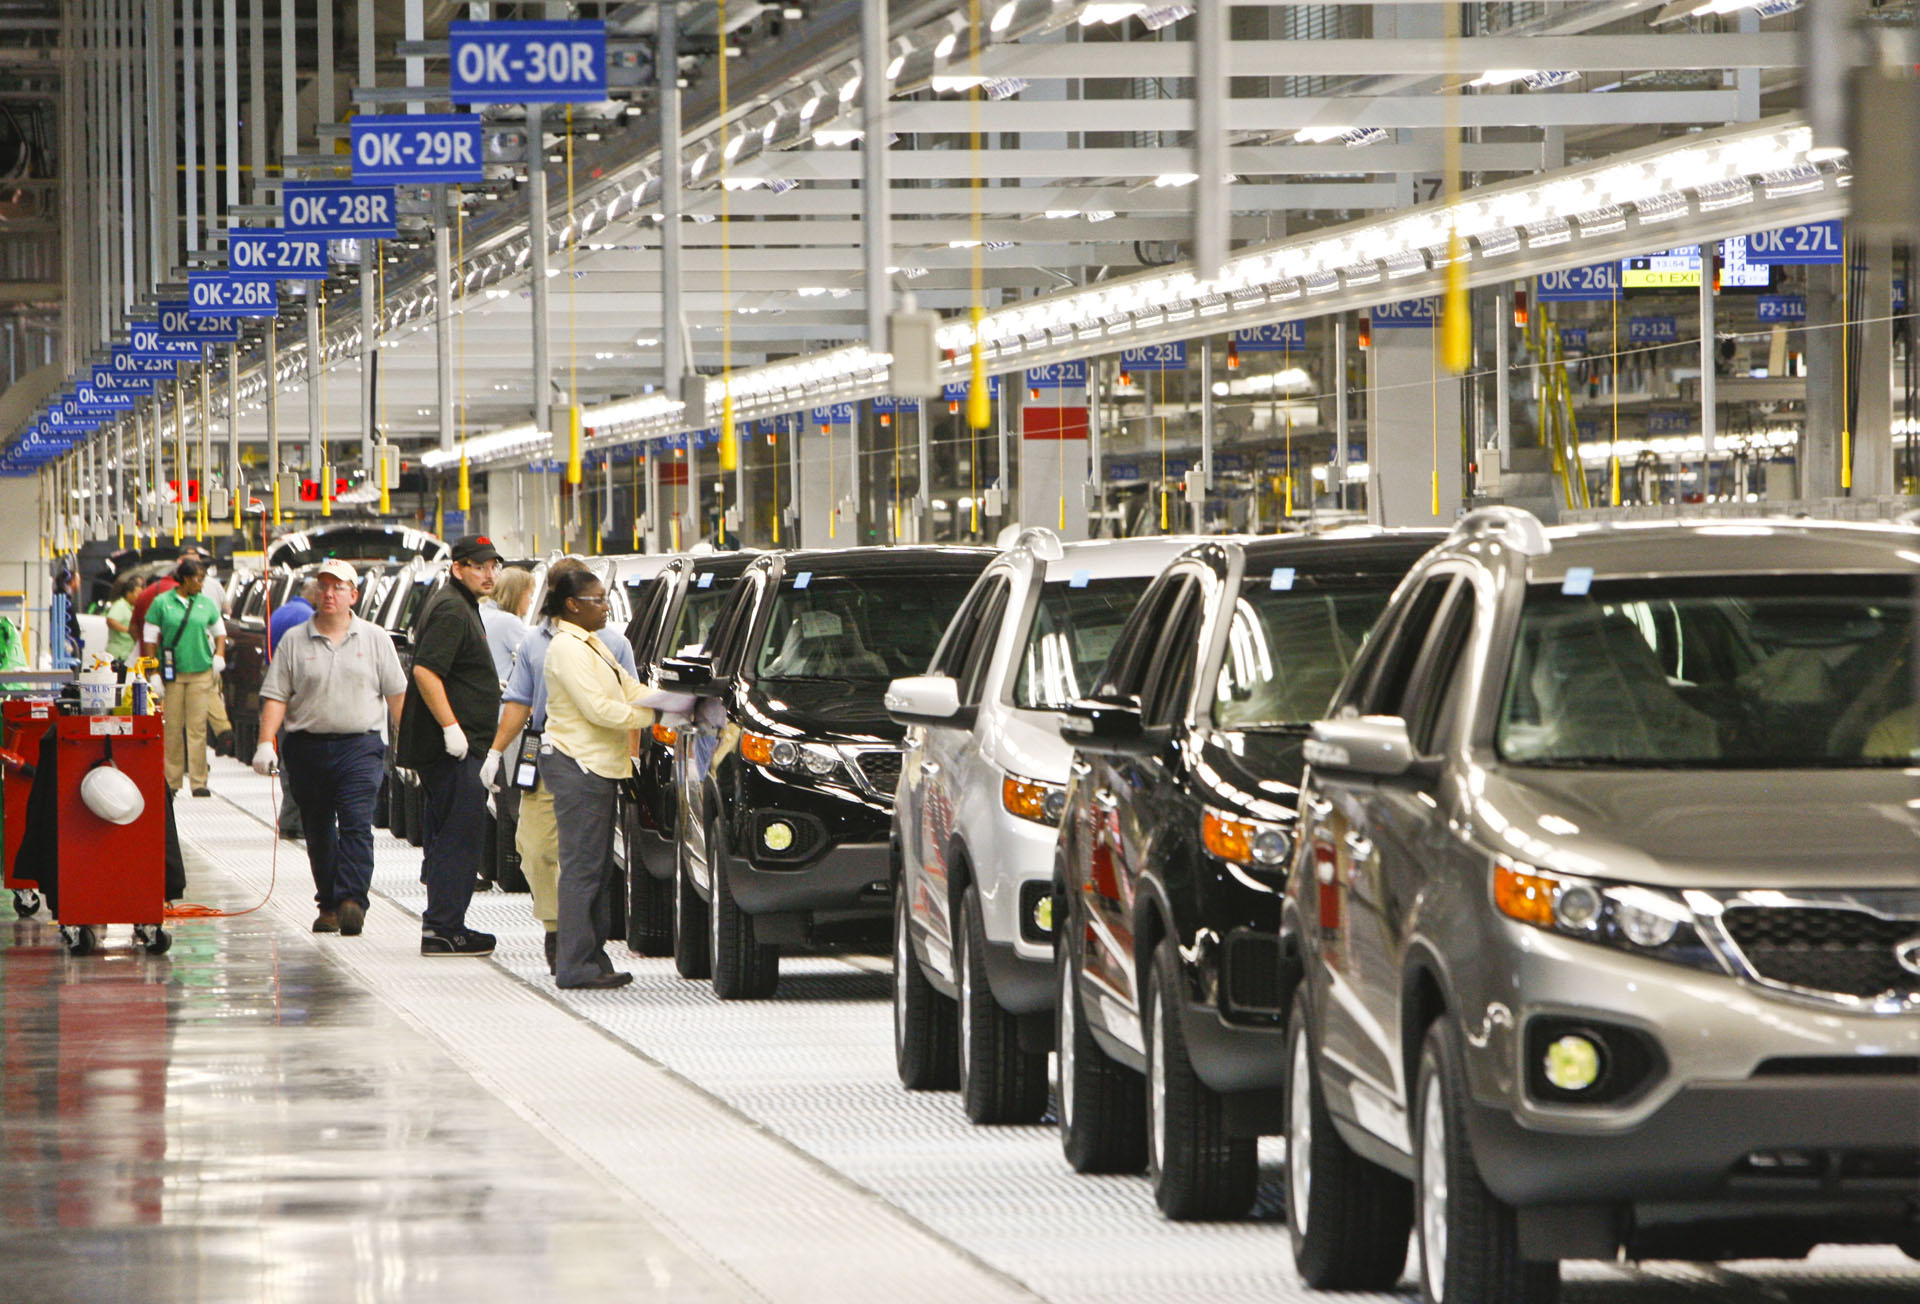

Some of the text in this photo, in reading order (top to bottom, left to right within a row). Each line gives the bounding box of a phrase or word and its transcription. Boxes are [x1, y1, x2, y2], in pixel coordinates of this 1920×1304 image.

[457, 42, 598, 84] OK-30R
[358, 131, 475, 167] OK-29R
[289, 195, 390, 226] OK-28R
[1751, 226, 1838, 252] OK-27L
[233, 241, 322, 267] OK-27R
[1729, 250, 1746, 260] 12
[1541, 266, 1619, 290] OK-26L
[193, 282, 272, 306] OK-26R
[1376, 297, 1445, 318] OK-25L
[1759, 302, 1805, 317] F2-11L
[162, 311, 233, 332] OK-25R
[1240, 322, 1302, 341] OK-24L
[1631, 323, 1674, 337] F2-12L
[1125, 343, 1183, 362] OK-23L
[1030, 363, 1083, 380] OK-22L
